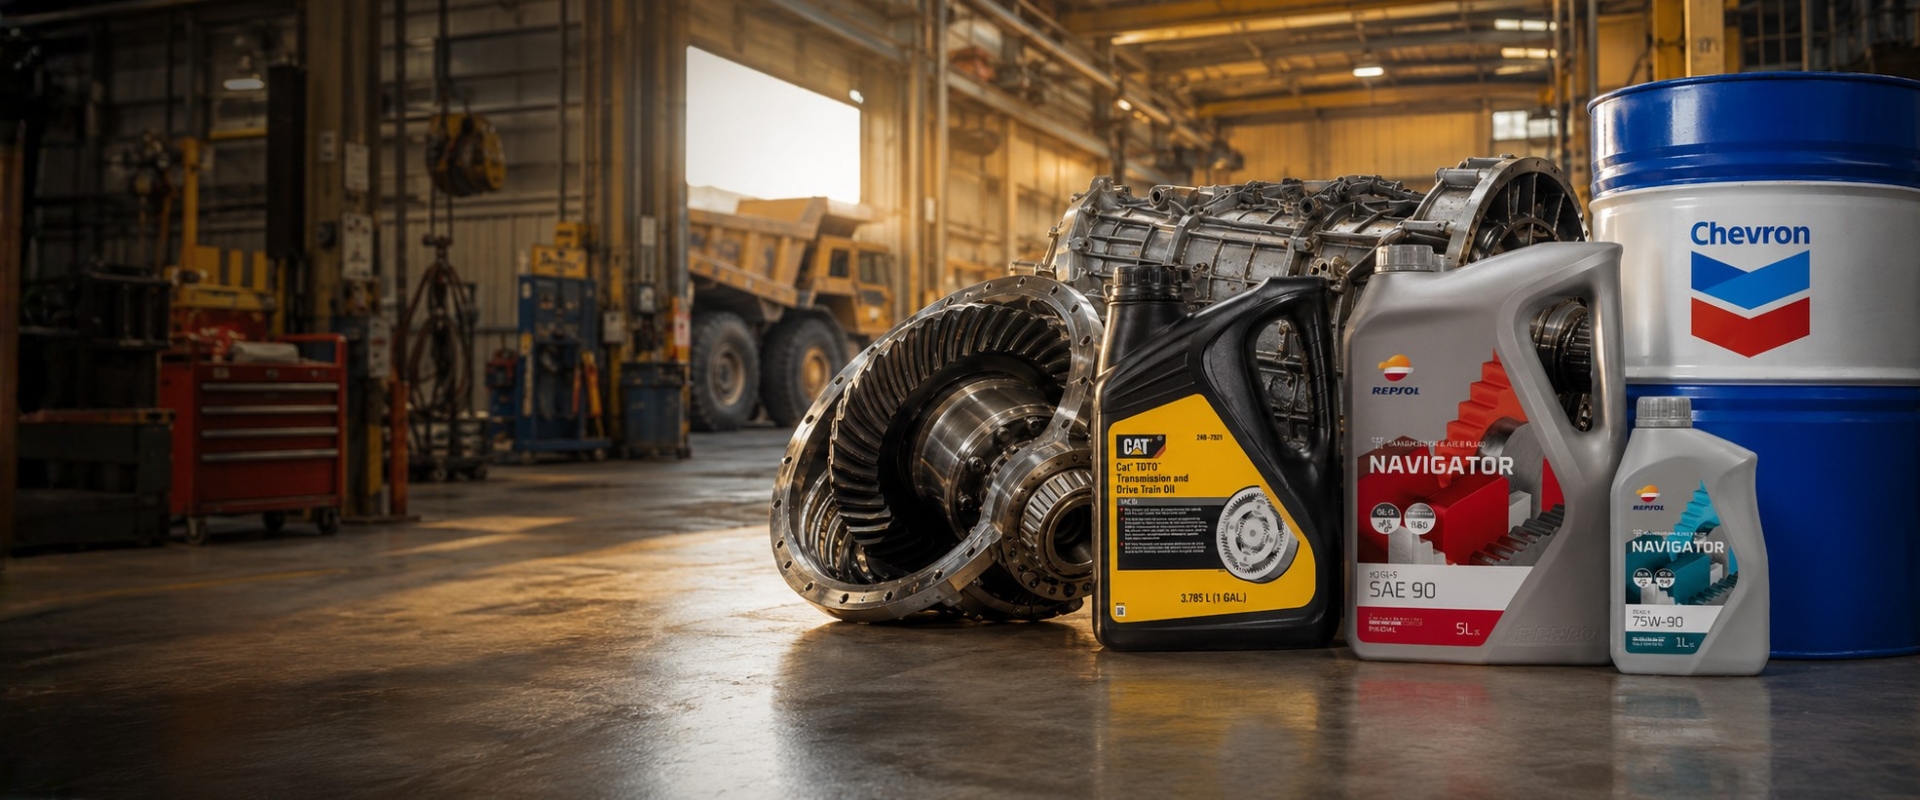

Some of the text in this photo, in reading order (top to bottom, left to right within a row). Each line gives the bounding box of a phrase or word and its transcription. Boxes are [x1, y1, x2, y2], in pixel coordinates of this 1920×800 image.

[1690, 221, 1810, 246] Chevron
[1371, 386, 1420, 395] REPSOL
[1123, 438, 1149, 455] CAT
[1369, 455, 1514, 475] NAVIGATOR
[1116, 473, 1189, 483] Transmission and
[1116, 485, 1138, 494] Drive
[1140, 485, 1161, 494] Train
[1632, 540, 1725, 553] NAVIGATOR
[1369, 581, 1436, 599] SAE 90
[1180, 593, 1203, 603] 3.785
[1206, 593, 1211, 603] L
[1632, 616, 1684, 628] 75W-90
